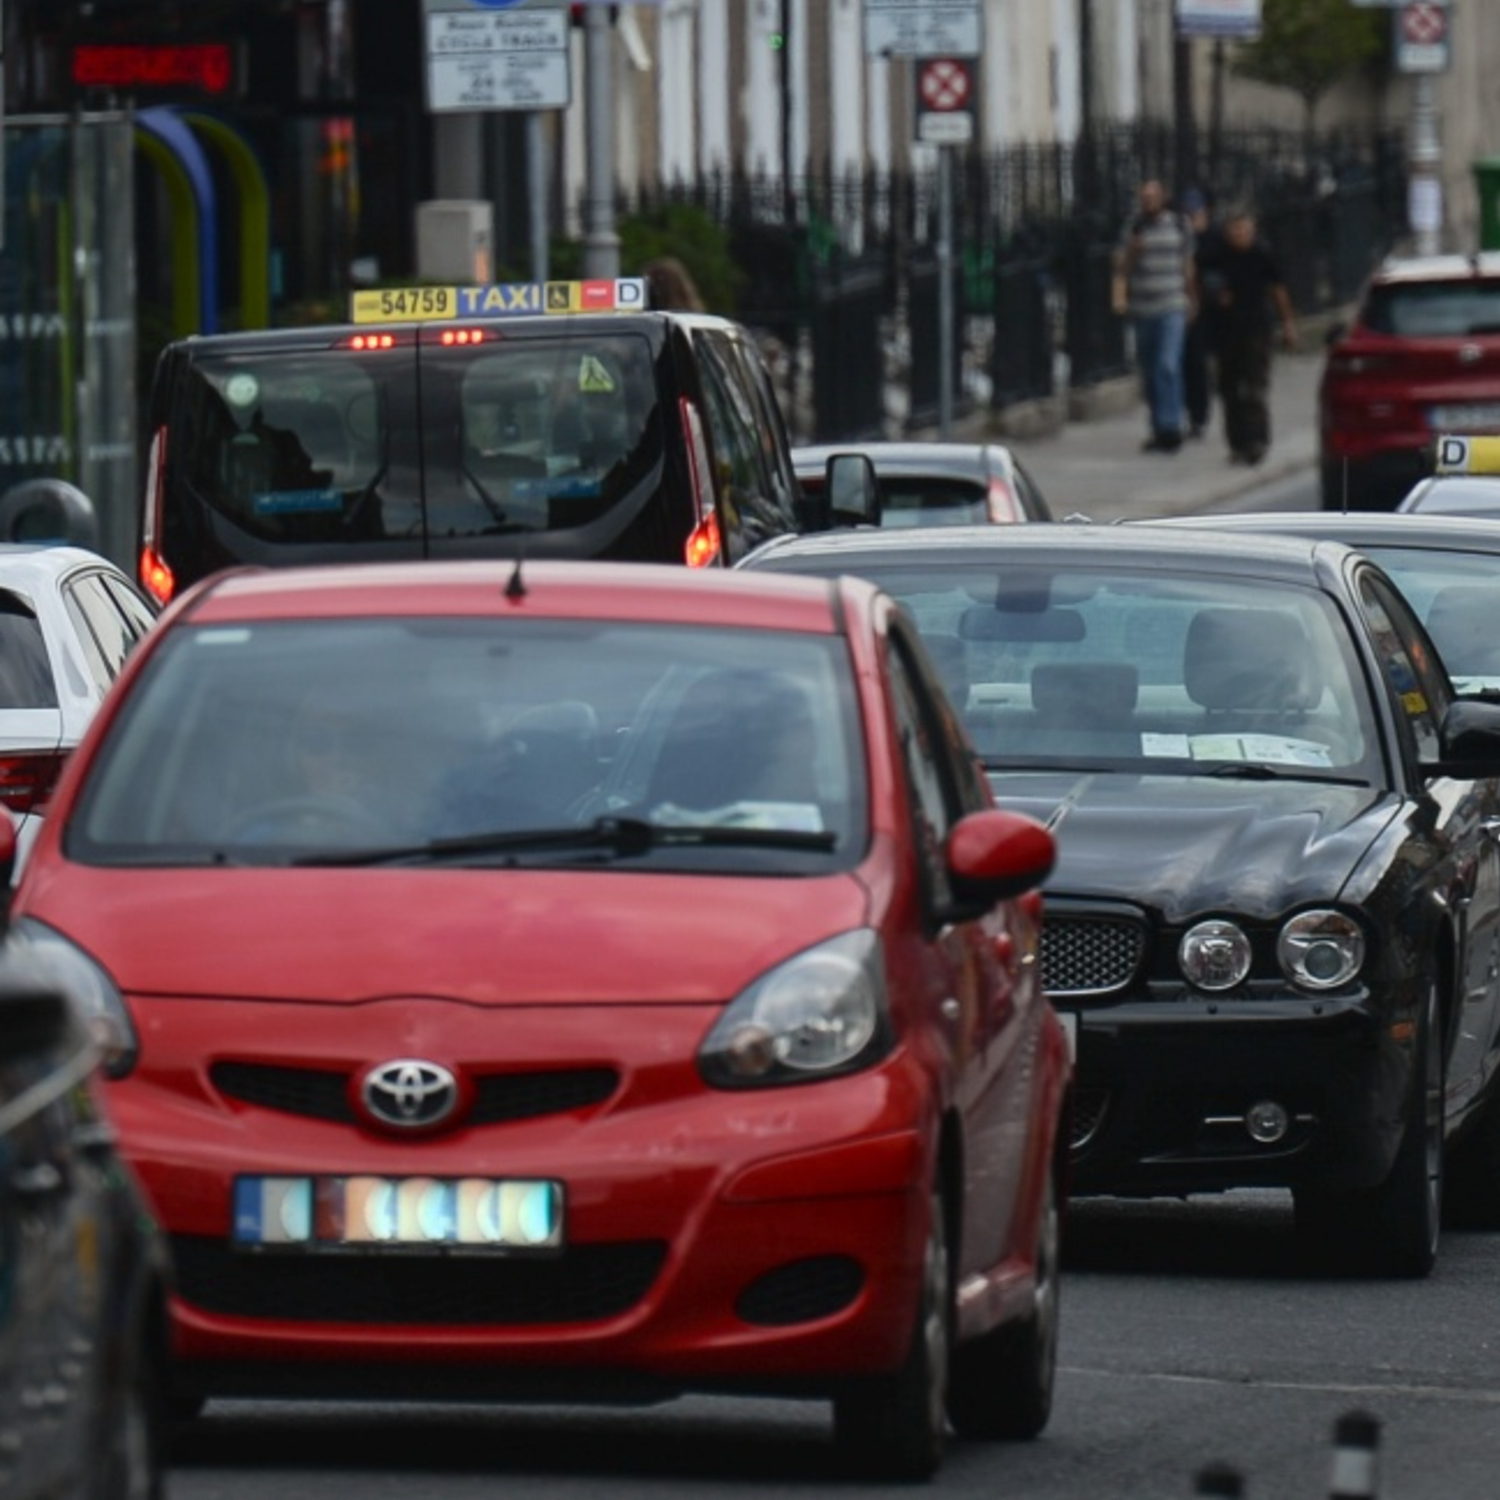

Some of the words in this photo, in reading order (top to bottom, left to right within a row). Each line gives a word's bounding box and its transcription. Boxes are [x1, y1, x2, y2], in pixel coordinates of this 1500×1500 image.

[381, 290, 447, 314] 54759
[462, 284, 540, 312] TAXI
[618, 283, 640, 303] D
[1442, 440, 1466, 466] D
